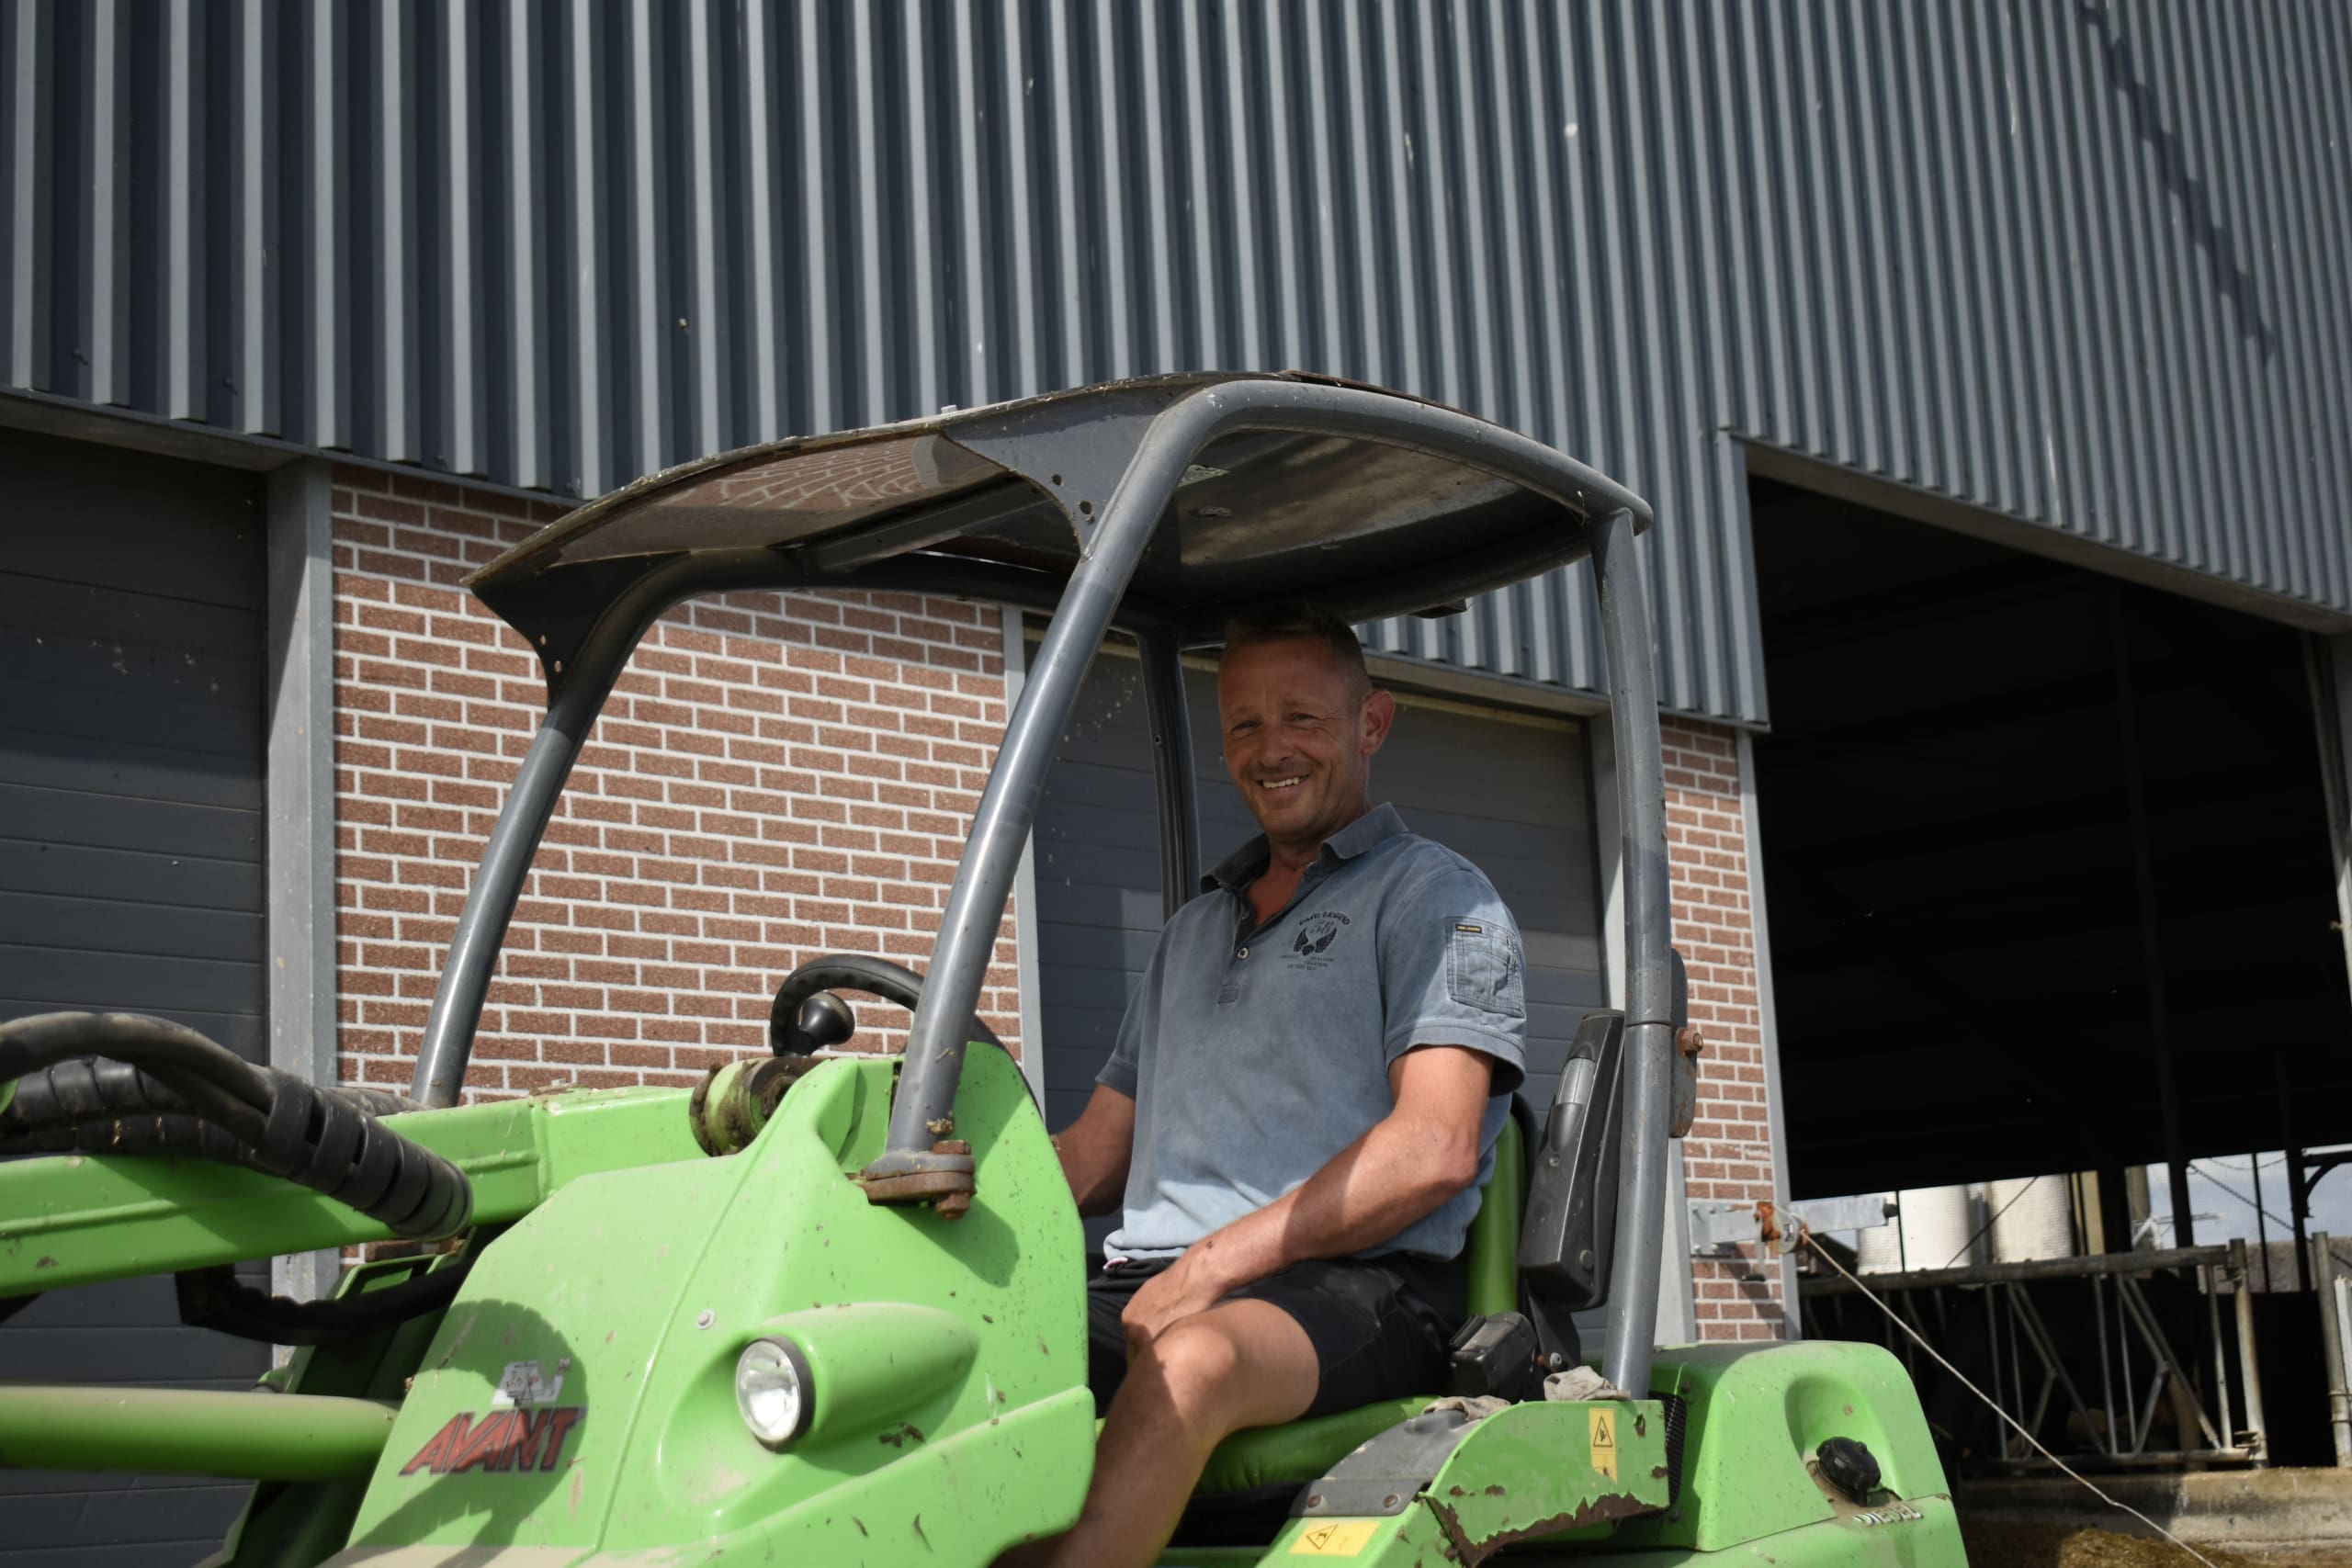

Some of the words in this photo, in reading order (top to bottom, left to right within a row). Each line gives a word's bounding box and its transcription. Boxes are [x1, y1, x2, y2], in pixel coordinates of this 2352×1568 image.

[1323, 911, 1351, 926] LEGEND
[398, 1406, 587, 1476] AVANT
[1852, 1505, 1924, 1525] DIESEL
